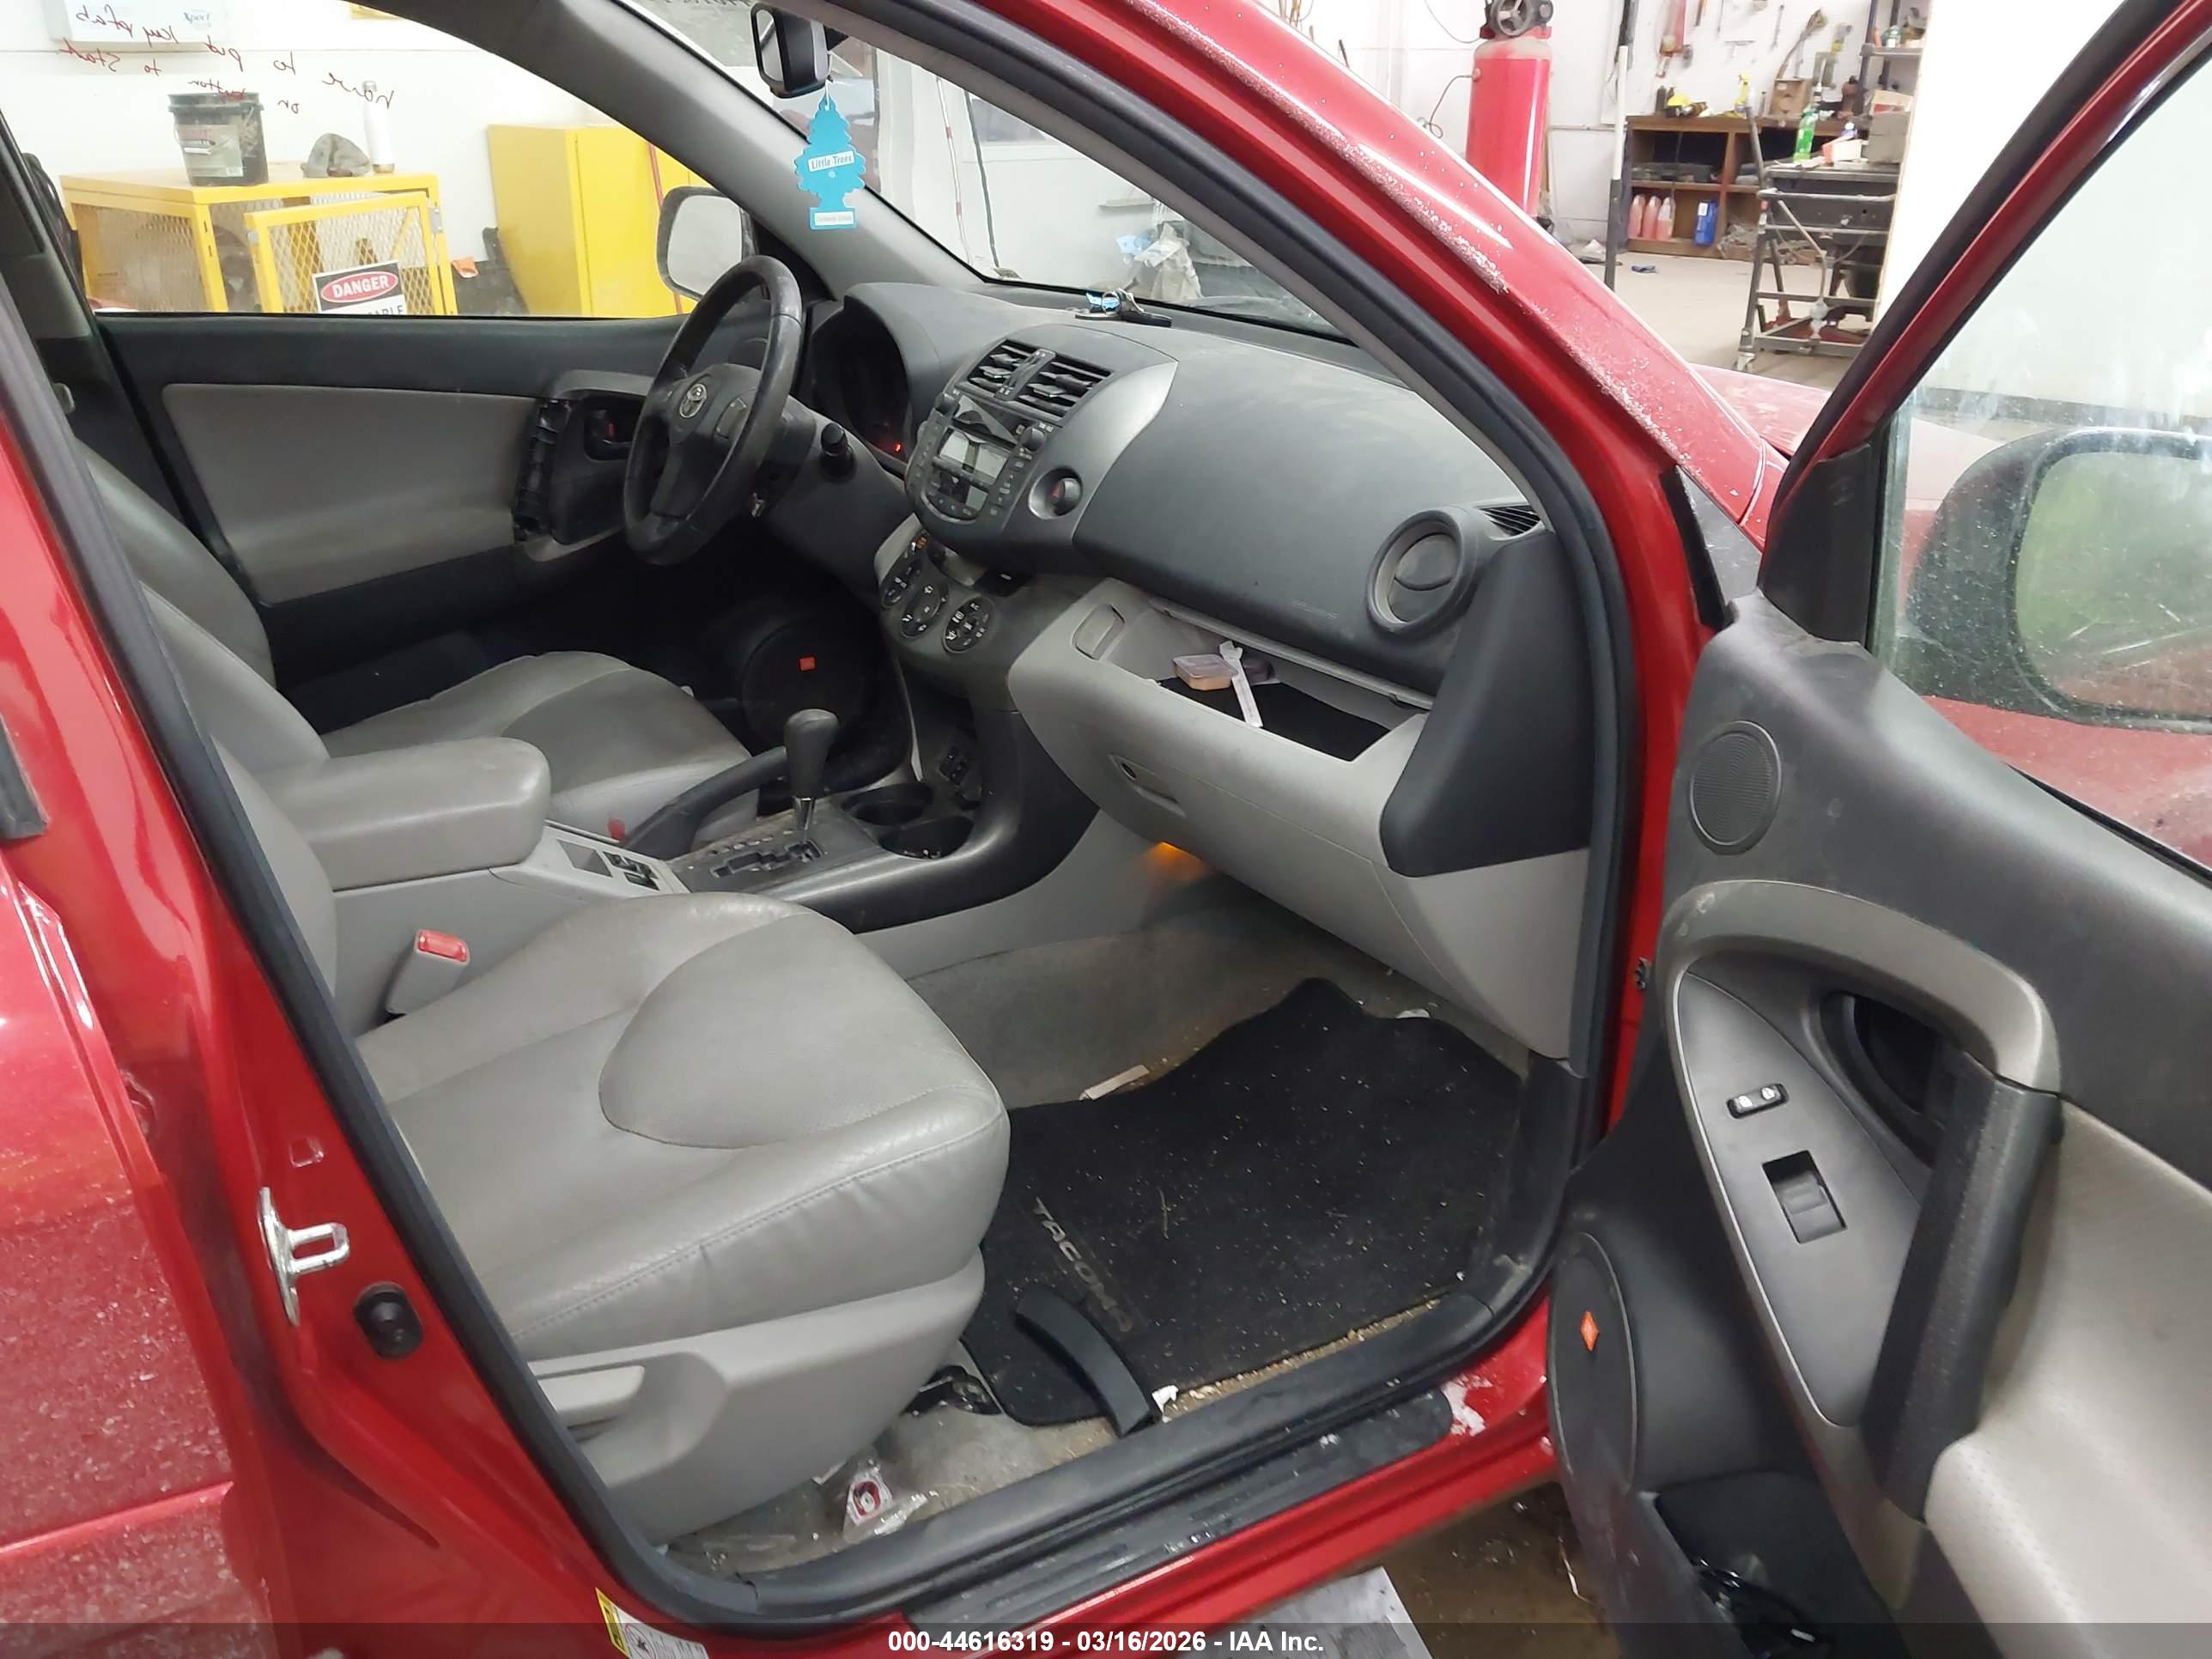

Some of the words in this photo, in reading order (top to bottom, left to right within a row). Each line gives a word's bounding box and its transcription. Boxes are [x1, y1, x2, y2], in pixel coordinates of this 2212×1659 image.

[811, 158, 831, 170] Little
[832, 155, 852, 166] Trees
[332, 275, 389, 298] DANGER
